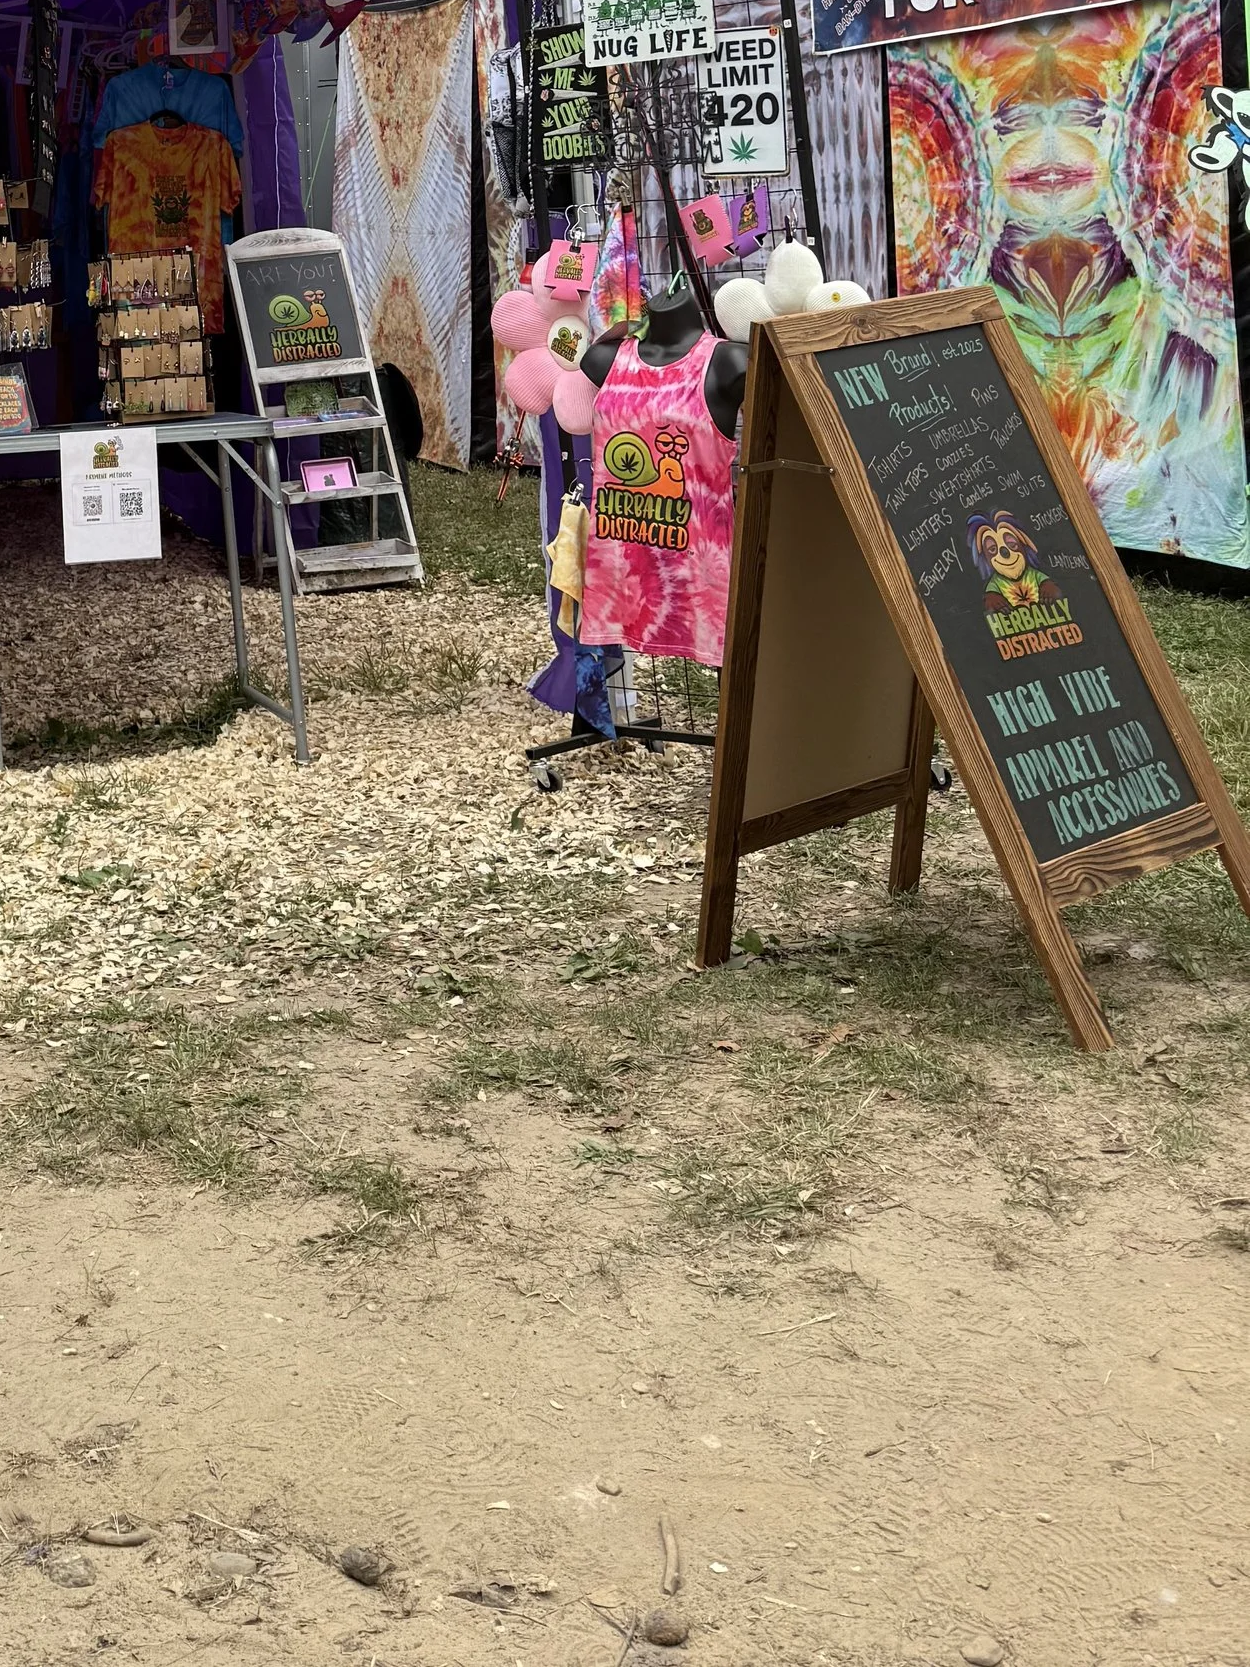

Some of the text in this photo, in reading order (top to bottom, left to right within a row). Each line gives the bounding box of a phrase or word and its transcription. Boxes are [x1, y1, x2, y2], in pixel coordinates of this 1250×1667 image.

[540, 29, 584, 63] SHOW
[593, 27, 708, 60] NUG LIFE
[554, 68, 575, 90] ME
[708, 64, 774, 88] LIMIT
[706, 91, 780, 127] 420
[271, 326, 338, 348] HERBALLY
[833, 362, 890, 409] NEW
[883, 342, 941, 375] Brand!
[889, 384, 958, 426] Products!
[928, 416, 990, 450] UMBRELLAS
[885, 482, 910, 515] TANK
[904, 462, 929, 492] TOPS
[929, 455, 996, 505] SWEATSHIRTS
[597, 489, 691, 525] HERBALLY
[901, 507, 953, 552] LIGHTERS
[999, 470, 1025, 492] SWIM
[919, 536, 964, 597] JEWELRY
[986, 598, 1073, 638] HERBALLY
[996, 622, 1084, 661] DISTRACTED
[986, 665, 1121, 737] HIGH VIBE
[1005, 720, 1154, 802] APPAREL AND
[1047, 760, 1181, 845] ACCESSORIES
